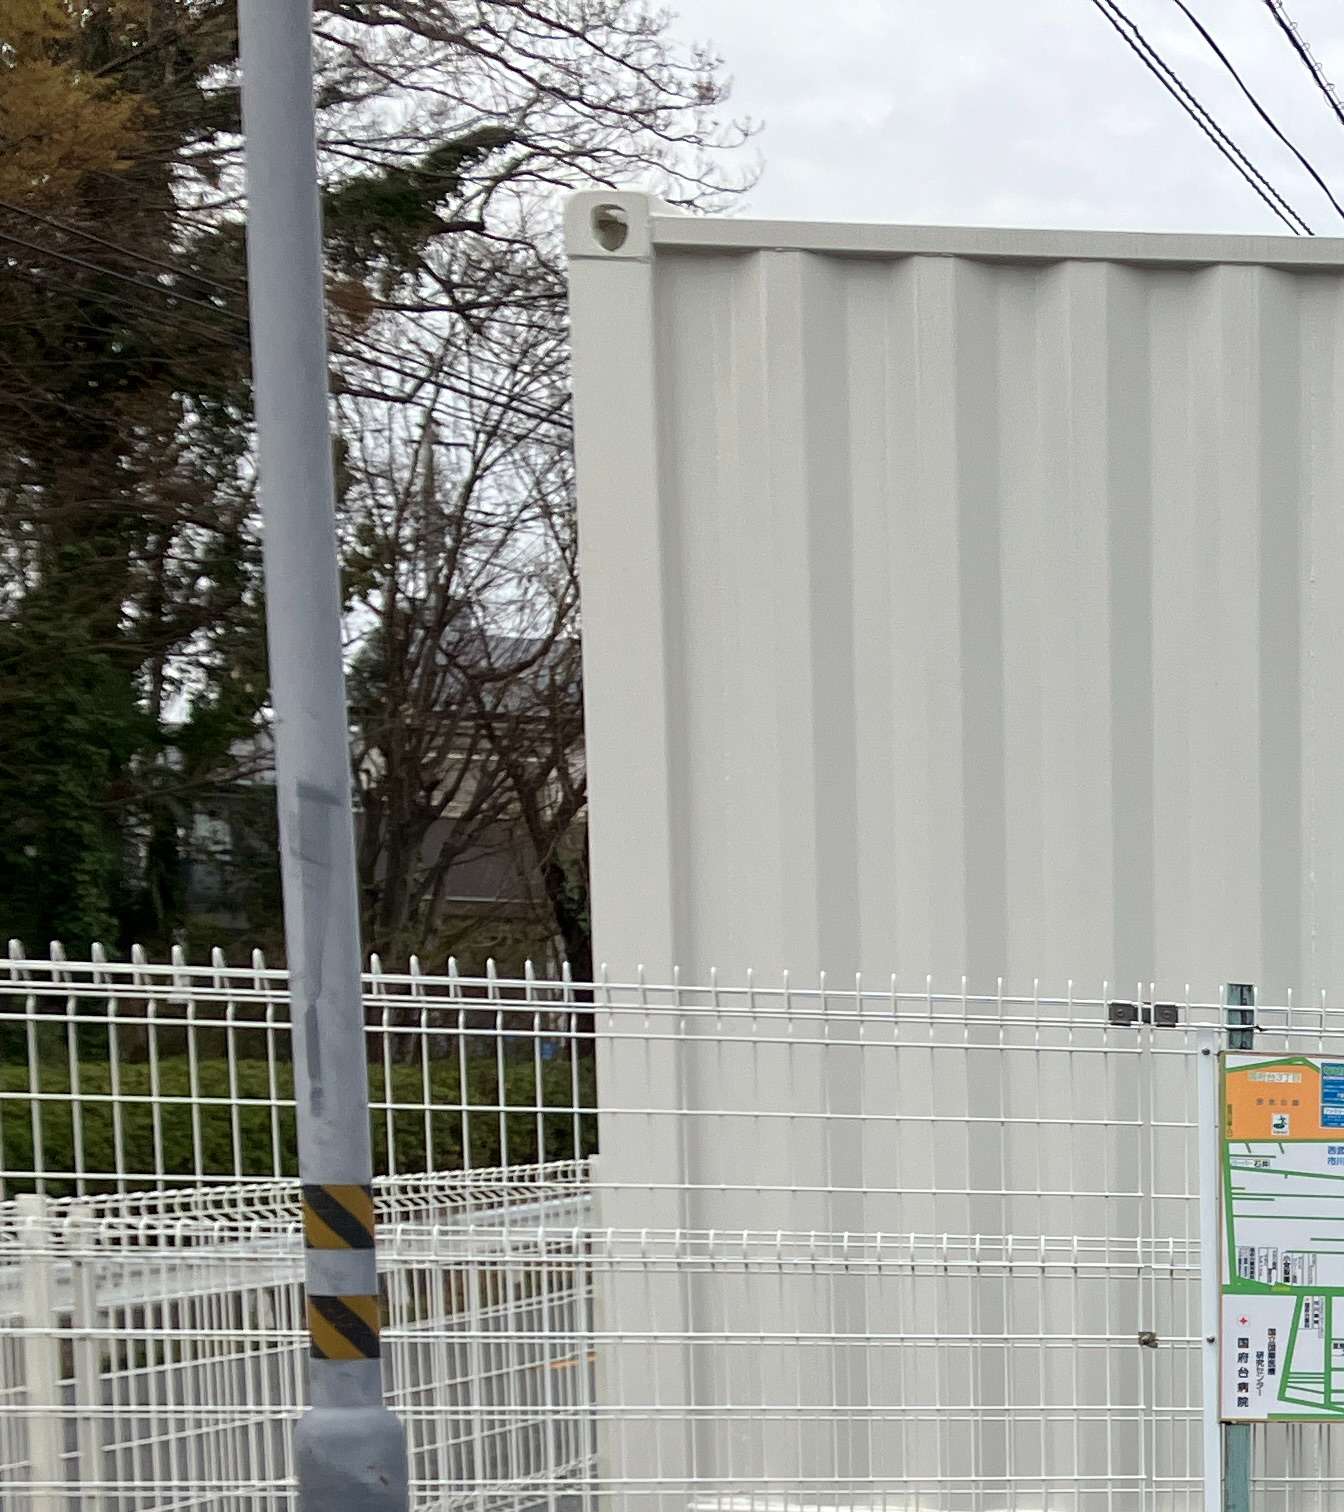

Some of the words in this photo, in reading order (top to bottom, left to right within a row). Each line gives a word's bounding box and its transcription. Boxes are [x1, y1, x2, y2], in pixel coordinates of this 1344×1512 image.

[1237, 1337, 1249, 1407] 国府台病院
